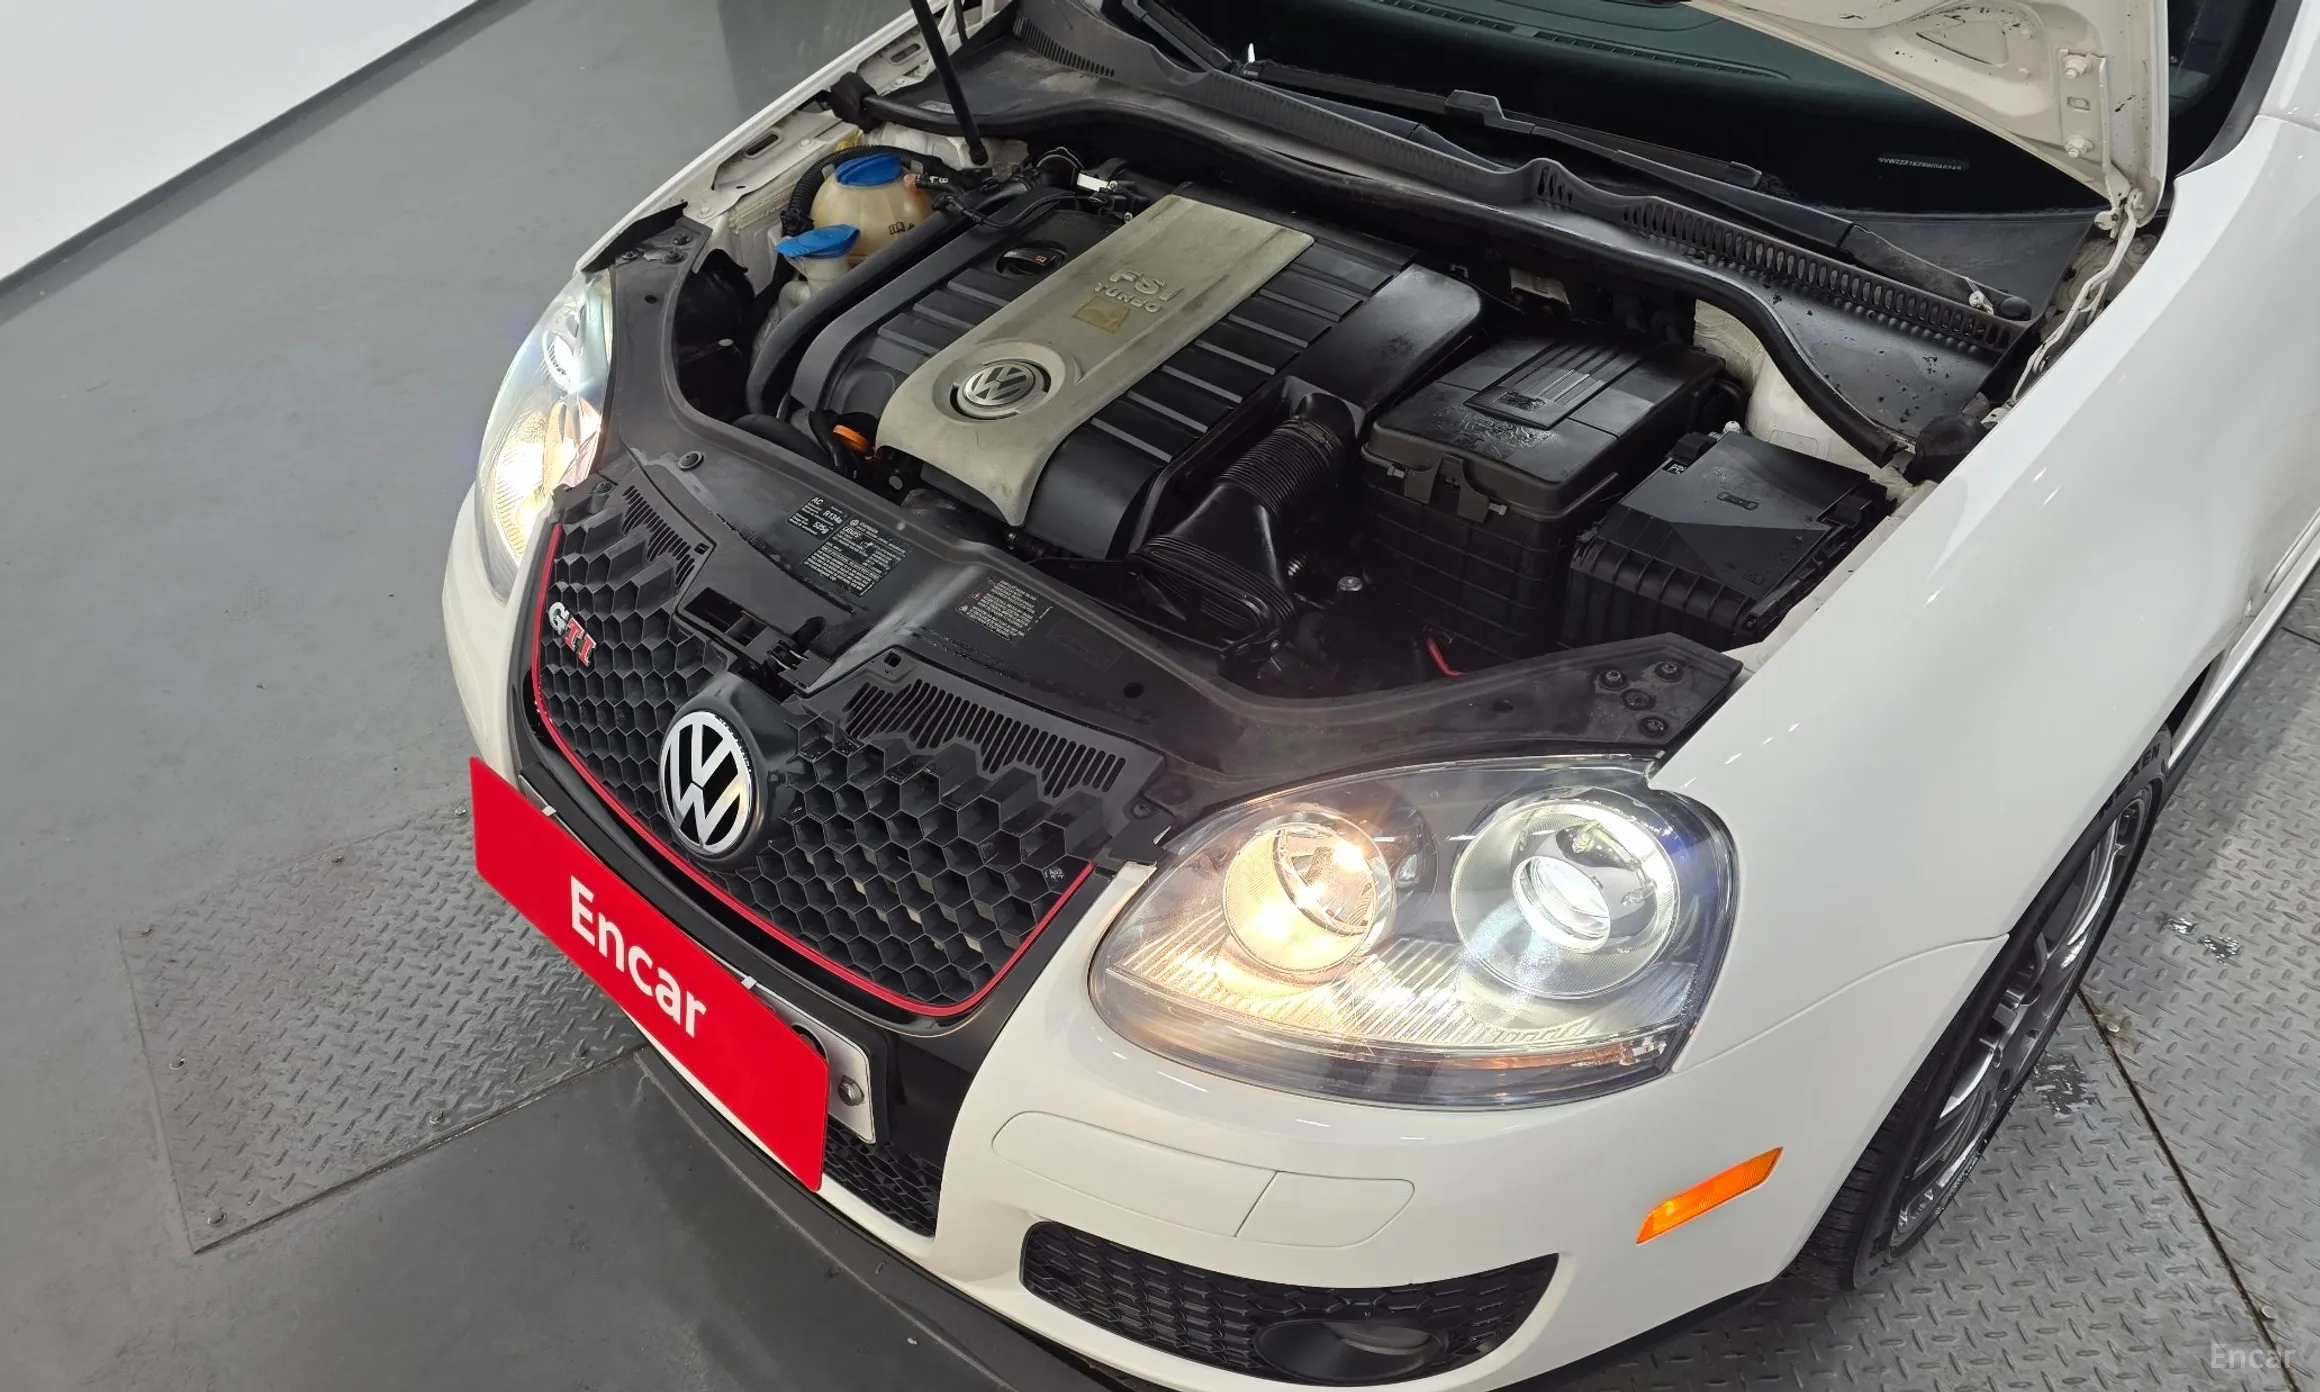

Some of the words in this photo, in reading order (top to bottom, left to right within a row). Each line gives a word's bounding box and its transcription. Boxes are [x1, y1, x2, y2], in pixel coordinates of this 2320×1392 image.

[1093, 282, 1162, 313] TURBO
[1109, 270, 1184, 301] FSI
[964, 363, 1035, 406] VW
[811, 496, 824, 505] AC
[549, 602, 597, 667] GTI
[660, 711, 752, 854] VW
[571, 875, 707, 1038] Encar
